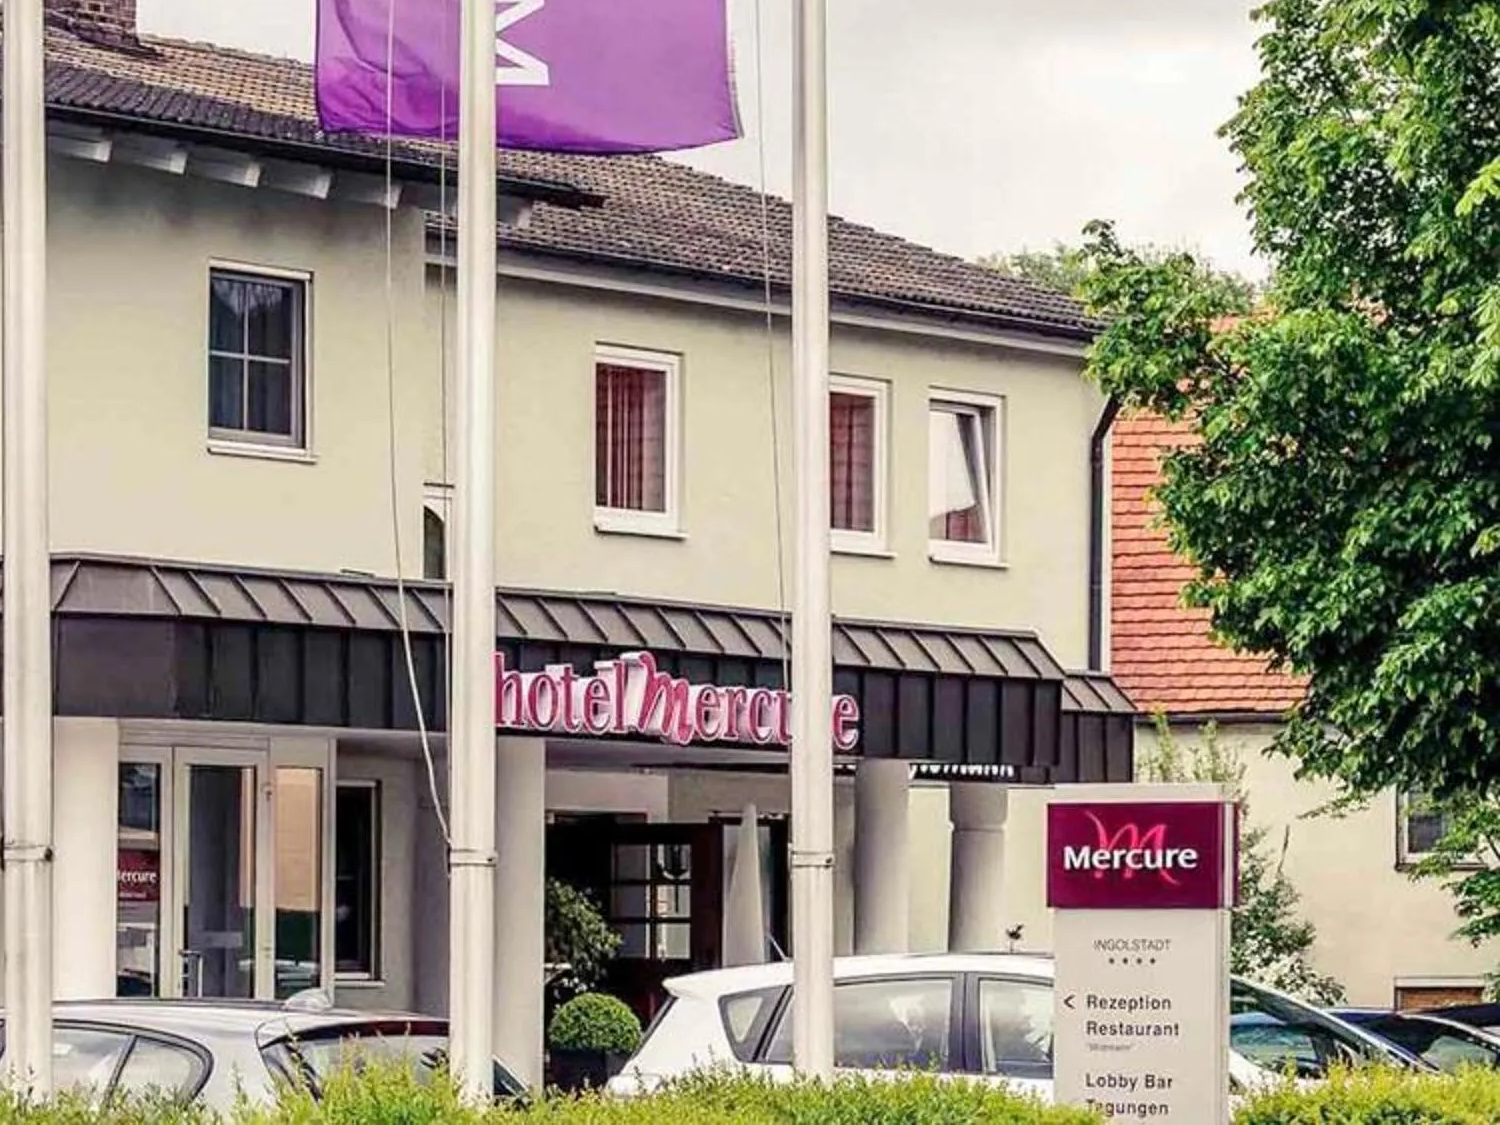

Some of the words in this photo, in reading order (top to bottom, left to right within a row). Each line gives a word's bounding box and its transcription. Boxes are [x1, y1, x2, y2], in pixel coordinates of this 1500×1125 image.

[492, 651, 628, 734] hotel
[1062, 845, 1198, 871] Mercure
[117, 871, 157, 883] ercure
[1093, 938, 1172, 952] INGOLSTADT
[1086, 994, 1172, 1014] Rezeption
[1086, 1021, 1180, 1037] Restaurant
[1085, 1073, 1139, 1091] Lobby
[1144, 1074, 1173, 1089] Bar
